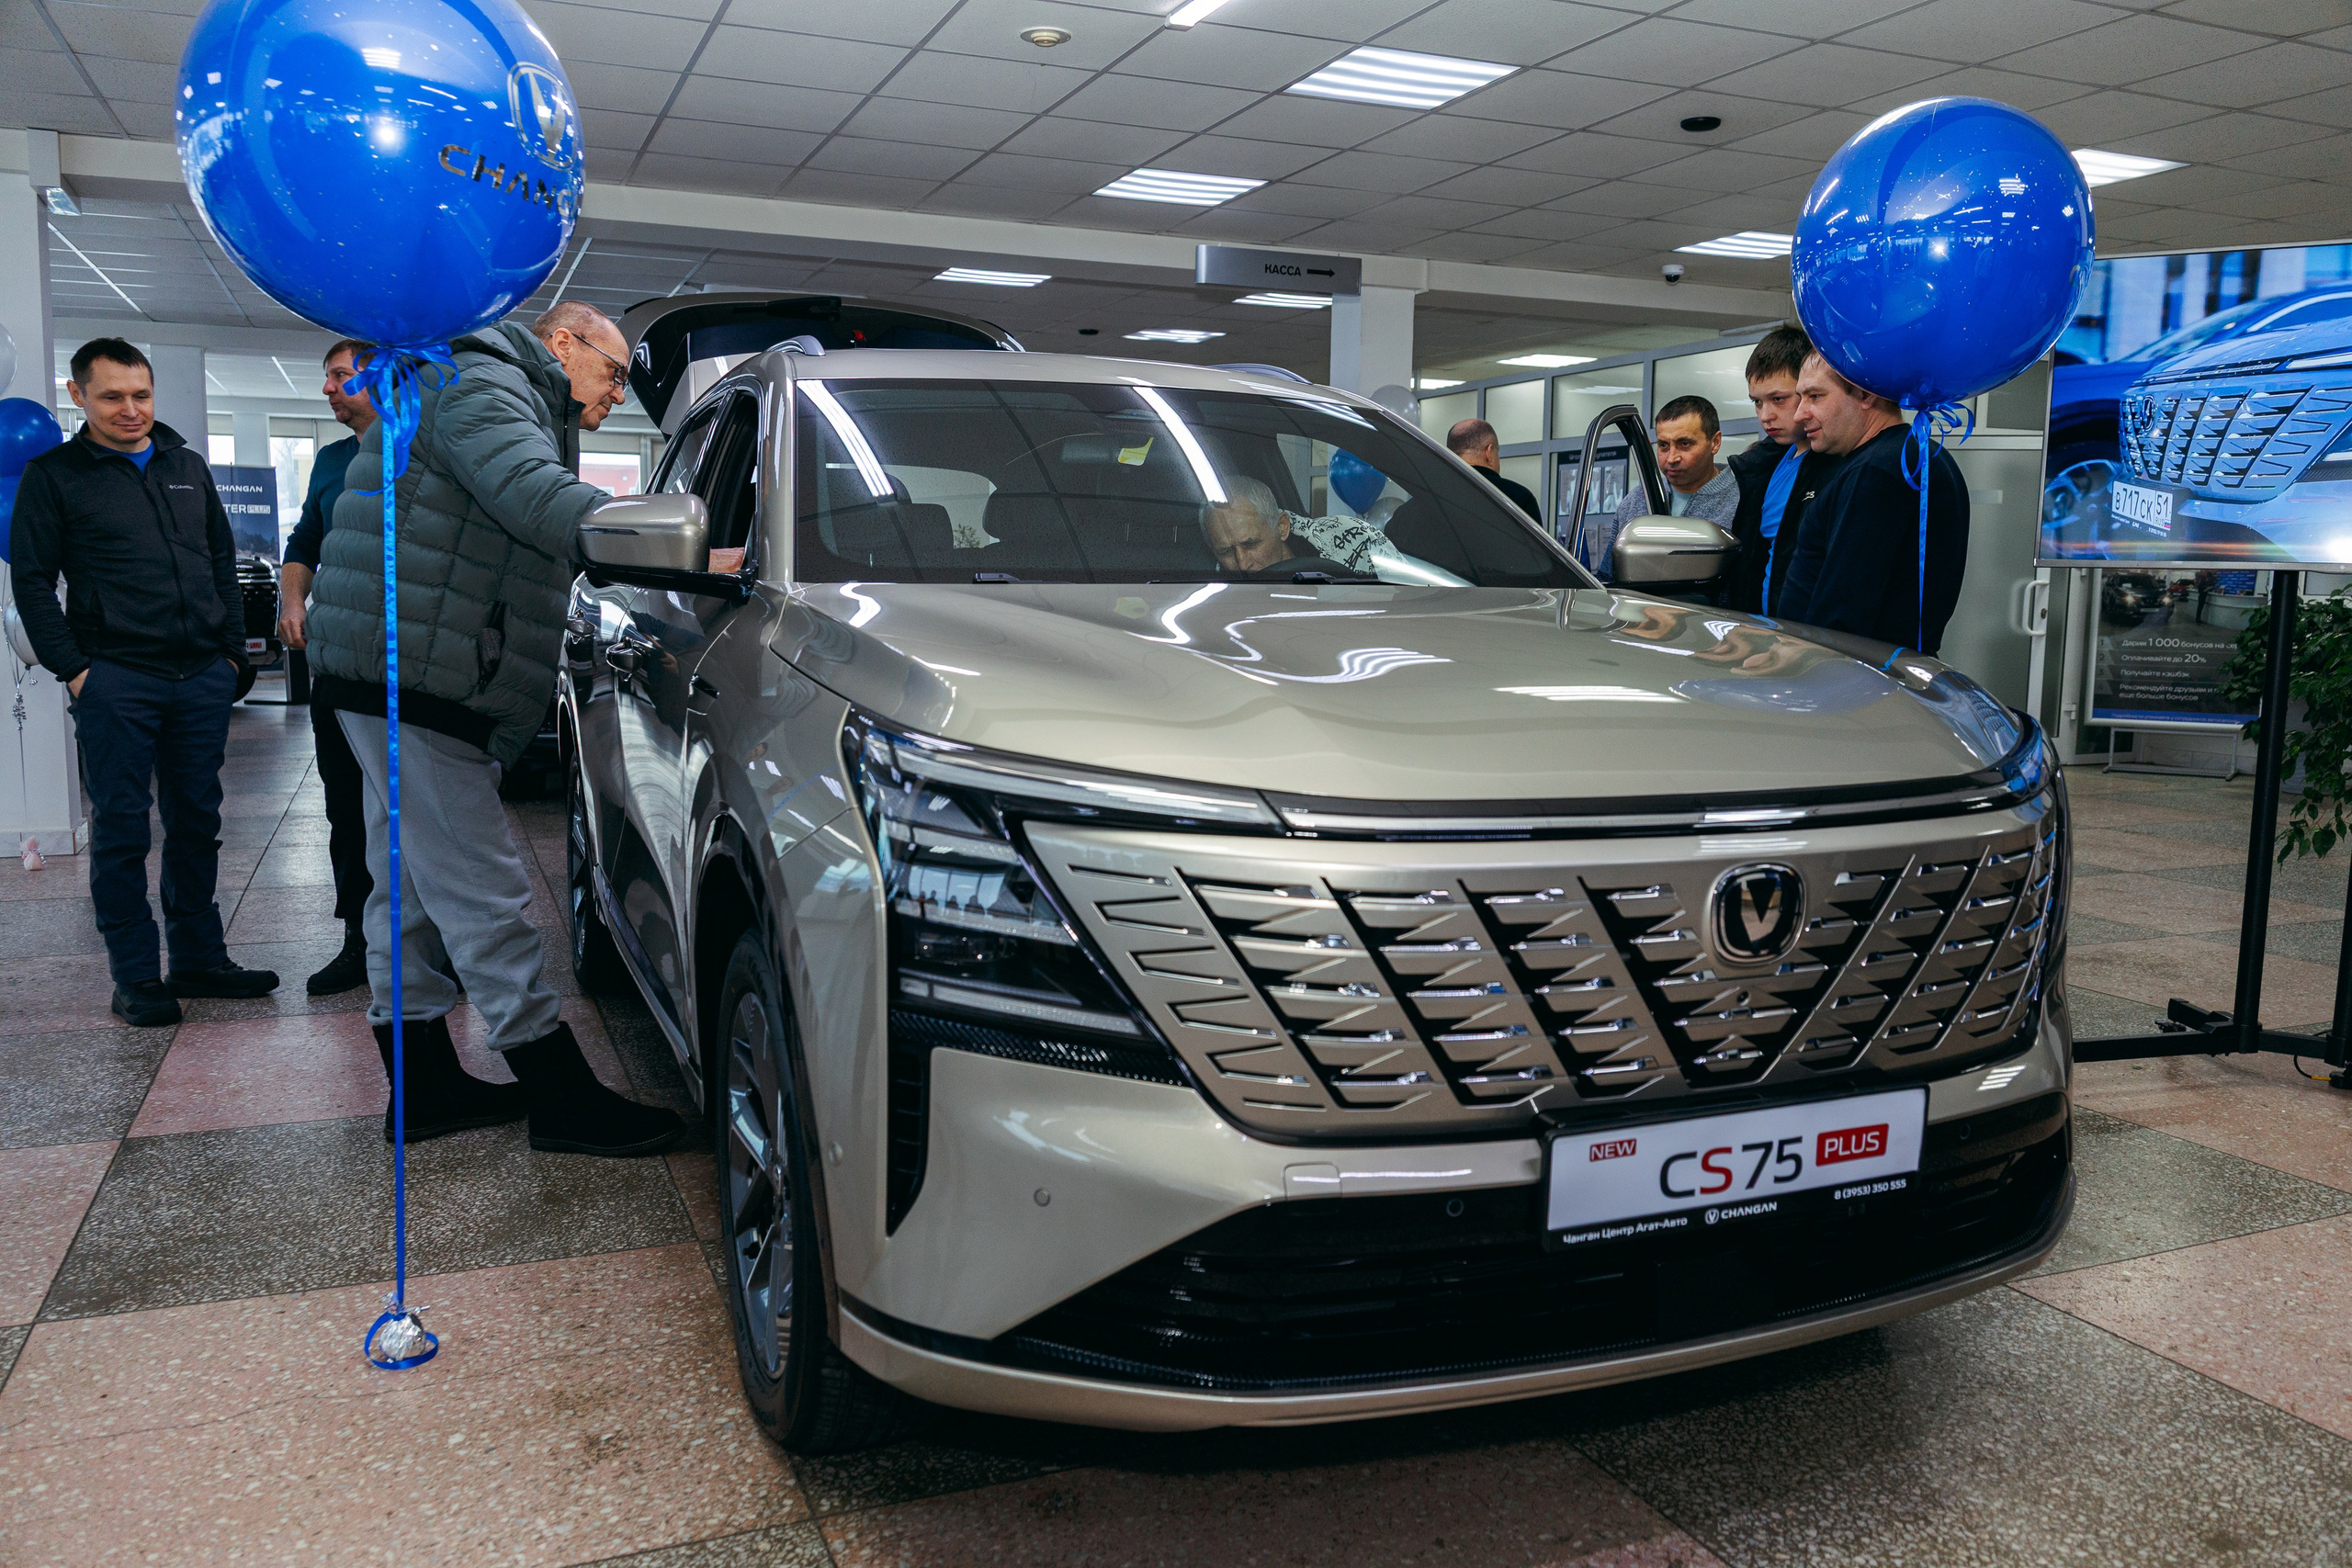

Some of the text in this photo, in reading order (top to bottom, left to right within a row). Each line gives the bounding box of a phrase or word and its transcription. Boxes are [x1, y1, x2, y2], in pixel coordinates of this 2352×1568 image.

[438, 143, 572, 218] CHANG
[1264, 264, 1302, 276] КАССА
[216, 484, 263, 492] CHANGAN
[222, 503, 270, 513] TER PLUS
[2155, 494, 2169, 518] 51
[2154, 517, 2165, 527] RUS
[2121, 639, 2147, 648] Дарим
[2147, 637, 2153, 647] 1
[2154, 637, 2180, 648] 000
[2180, 640, 2213, 649] бонусов
[2120, 654, 2172, 662] Оплачивайте
[2184, 653, 2207, 663] 20%
[2120, 669, 2190, 678] Получайте кэшбэк
[2119, 683, 2174, 693] Рекомендуйте
[2135, 692, 2165, 700] больше
[2165, 693, 2199, 702] бонусов
[1591, 1140, 1636, 1161] NEW
[1659, 1131, 1880, 1200] CS75 PLUS
[1834, 1179, 1907, 1200] 8 (3953) 350 555
[1721, 1201, 1778, 1220] CHANGAN
[1563, 1217, 1688, 1244] Чанган Центр Агат-Авто
